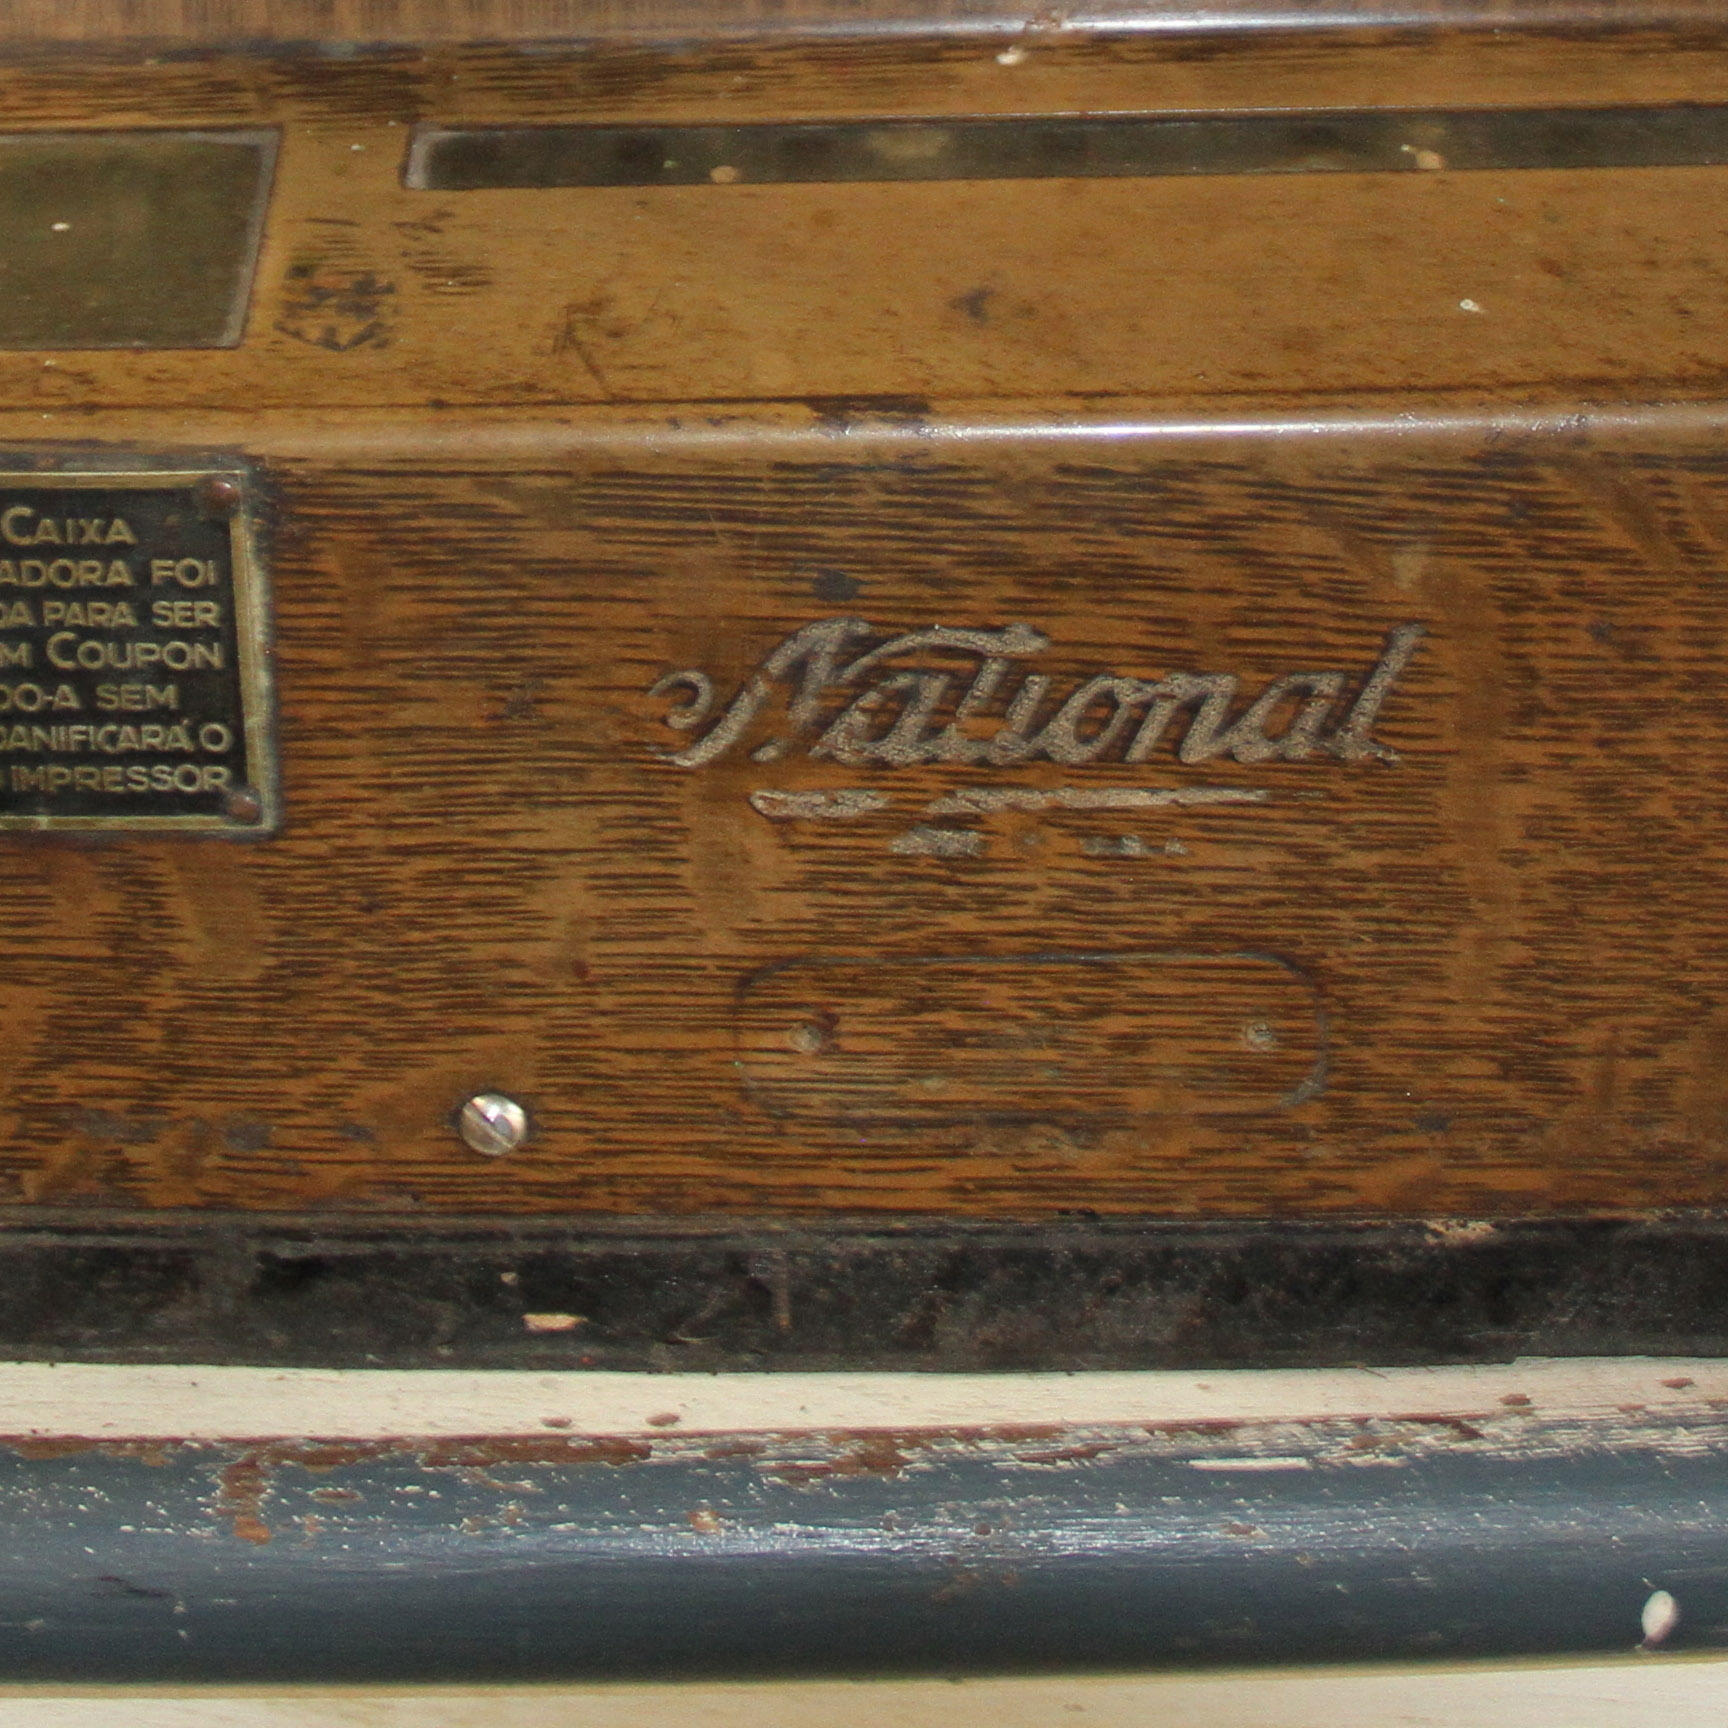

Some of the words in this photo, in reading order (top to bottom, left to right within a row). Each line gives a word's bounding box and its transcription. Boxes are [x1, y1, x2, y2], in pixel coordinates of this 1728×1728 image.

[150, 558, 218, 587] FOI
[41, 601, 138, 628] PARA
[151, 600, 221, 628] SER
[45, 630, 227, 671] COUPON
[95, 683, 180, 712] SEM
[647, 615, 1429, 770] National
[198, 722, 234, 754] O
[11, 763, 233, 794] IMPRESSOR
